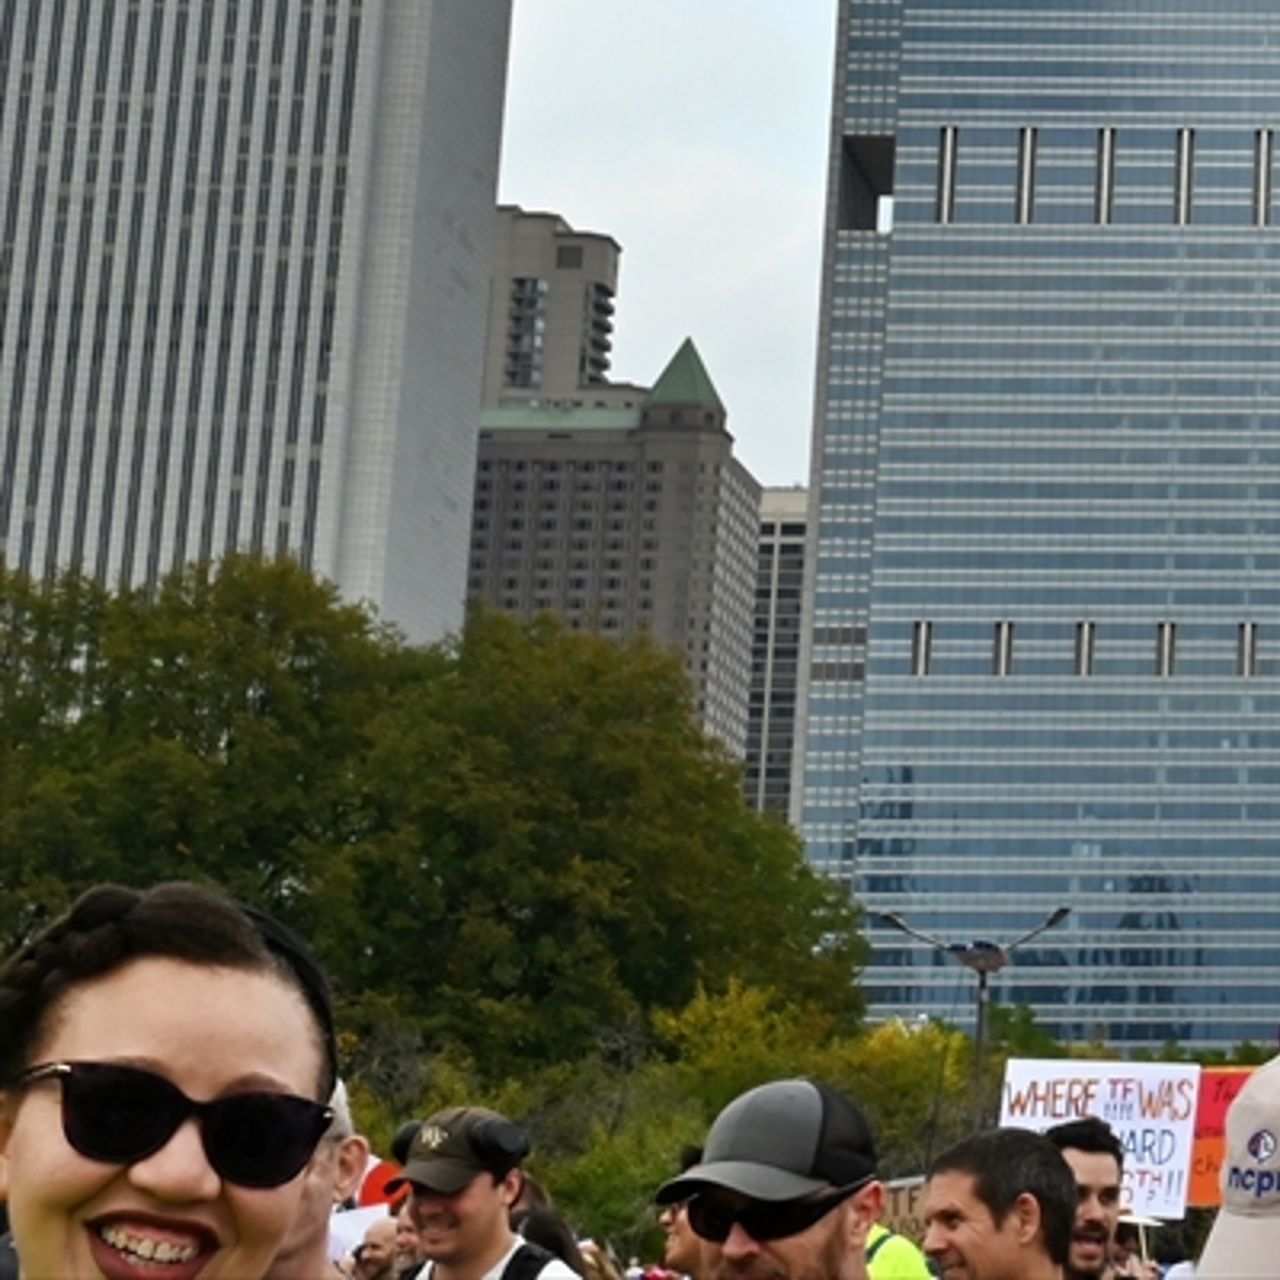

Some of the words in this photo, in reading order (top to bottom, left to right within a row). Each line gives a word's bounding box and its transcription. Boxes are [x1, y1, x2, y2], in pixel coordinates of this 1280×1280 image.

[1004, 1079, 1099, 1118] WHERE
[1107, 1078, 1135, 1101] TF
[1138, 1078, 1194, 1120] WAS
[1121, 1129, 1176, 1165] ARD
